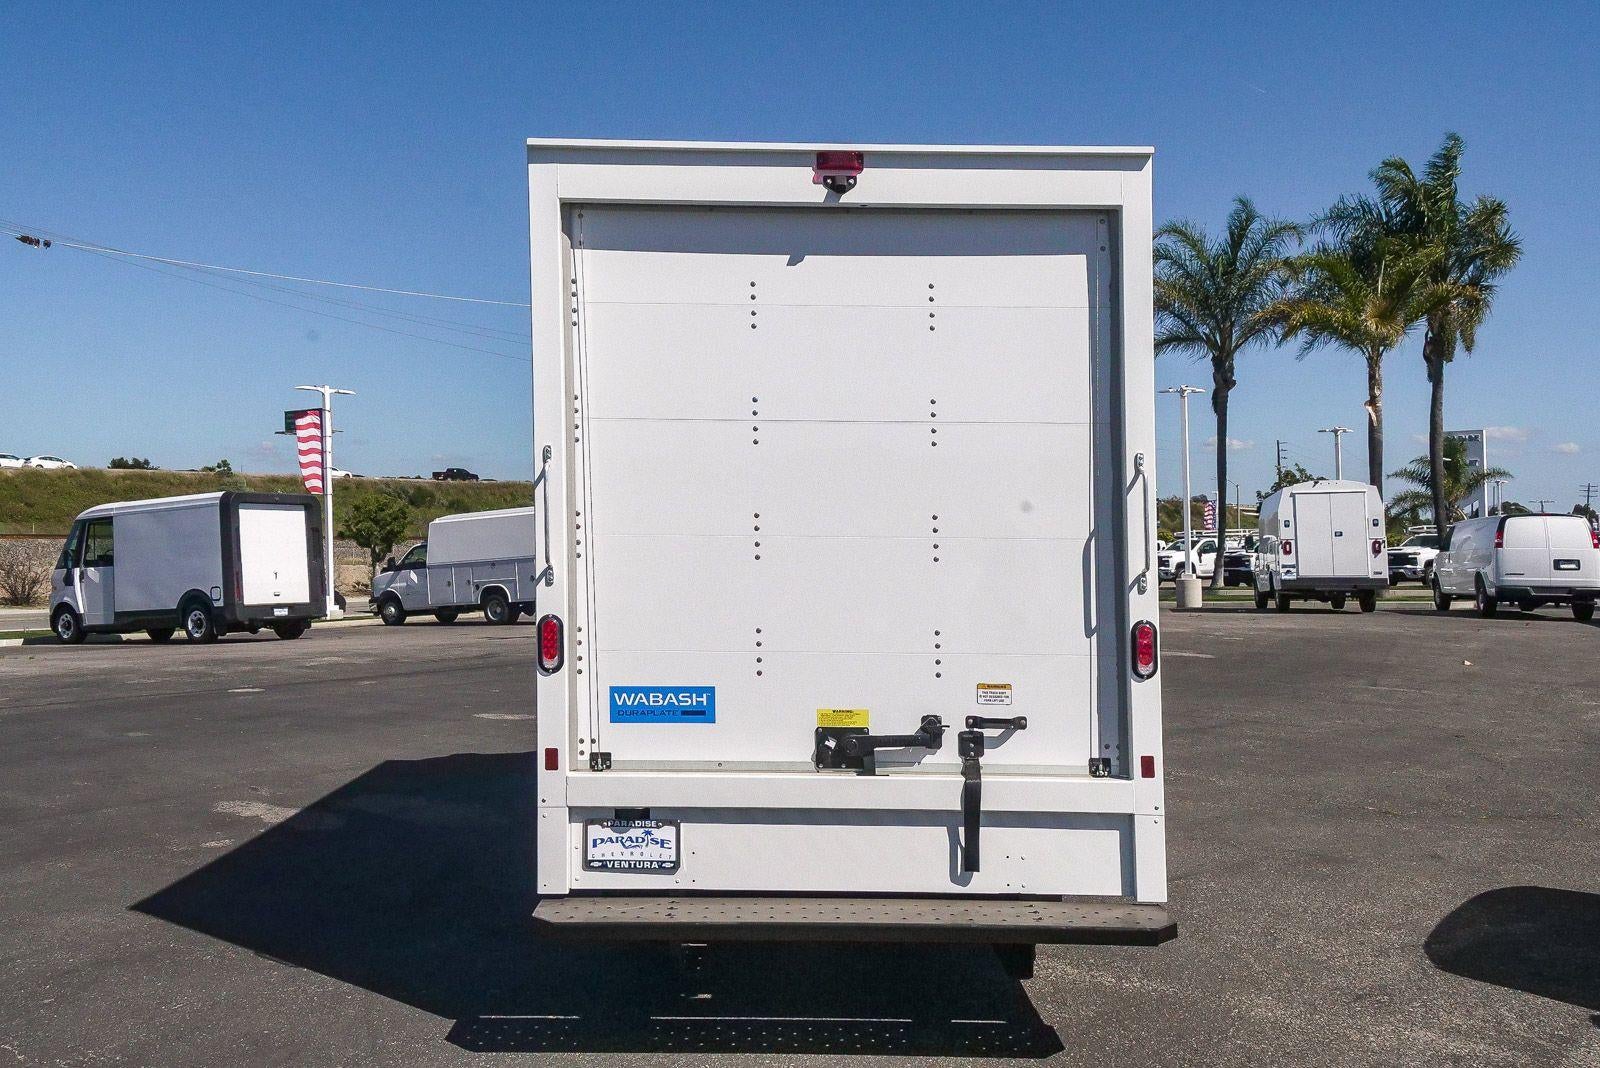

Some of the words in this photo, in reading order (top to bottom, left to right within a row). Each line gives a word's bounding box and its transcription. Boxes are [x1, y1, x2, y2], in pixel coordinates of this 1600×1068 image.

[614, 693, 707, 706] WABASH
[592, 830, 672, 849] PARADISE
[591, 851, 672, 860] CHEVROLET
